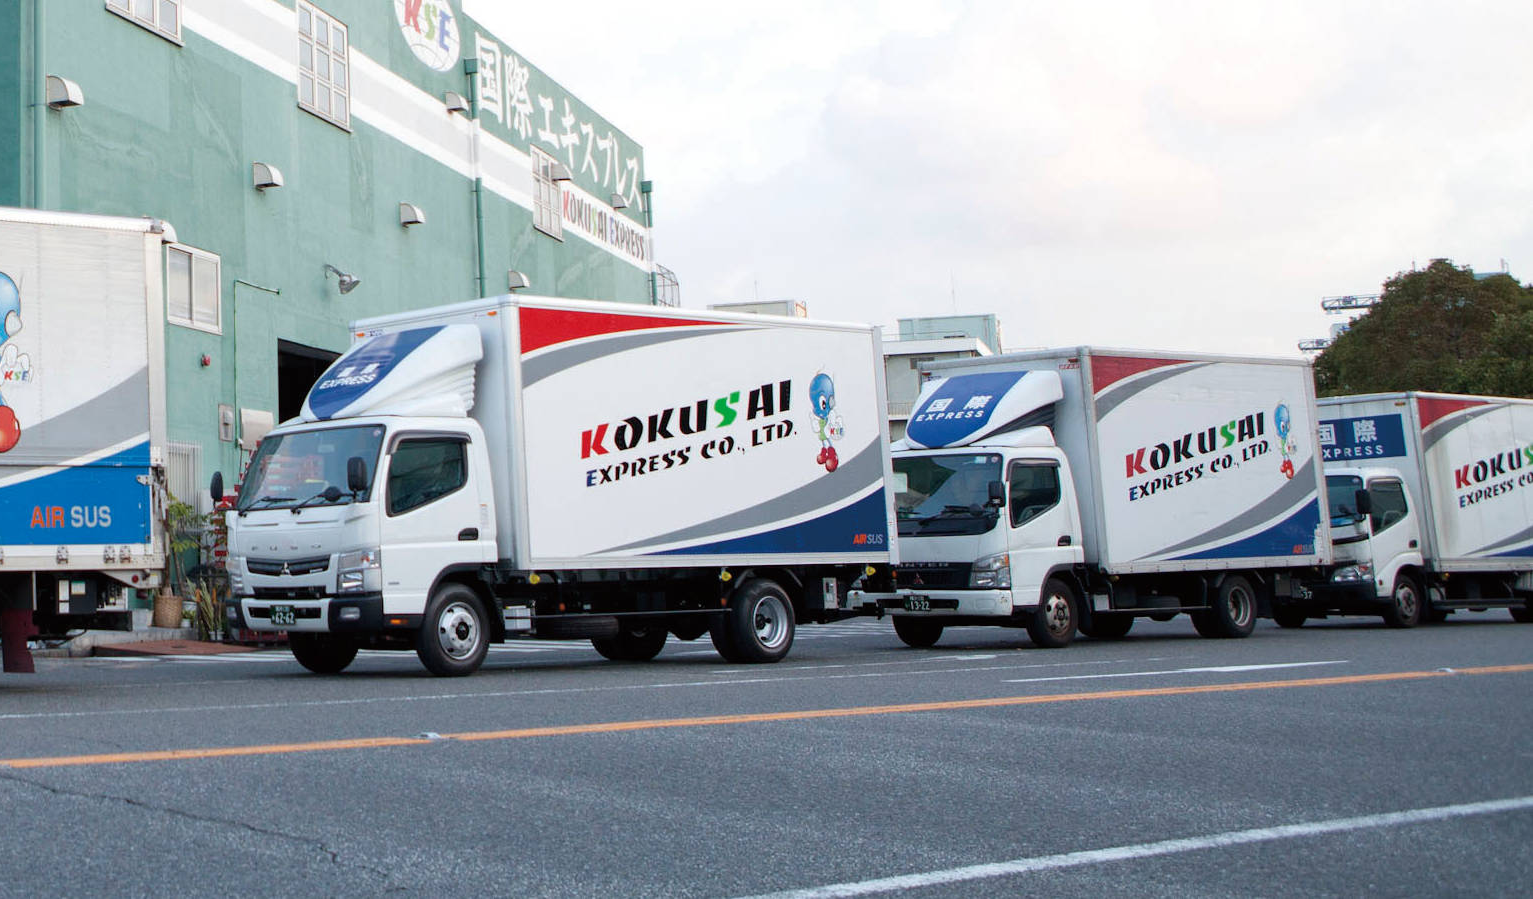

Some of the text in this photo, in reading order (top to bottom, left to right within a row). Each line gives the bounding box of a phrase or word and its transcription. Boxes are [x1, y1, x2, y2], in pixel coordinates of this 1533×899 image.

[563, 190, 644, 260] KOKUSAI EXPRESS
[4, 370, 29, 381] KSE
[319, 373, 377, 389] EXPRESS
[581, 379, 791, 459] KOKUSAI
[916, 410, 984, 422] EXPRESS
[586, 446, 691, 487] EXPRESS
[751, 419, 797, 447] LTD.
[1125, 412, 1264, 478] KOKUSAI
[1323, 445, 1384, 459] XPRESS
[1128, 463, 1204, 501] EXPRESS
[1242, 440, 1272, 462] LTD.
[1459, 478, 1514, 509] EXPRESS
[30, 505, 112, 528] AIR SUS
